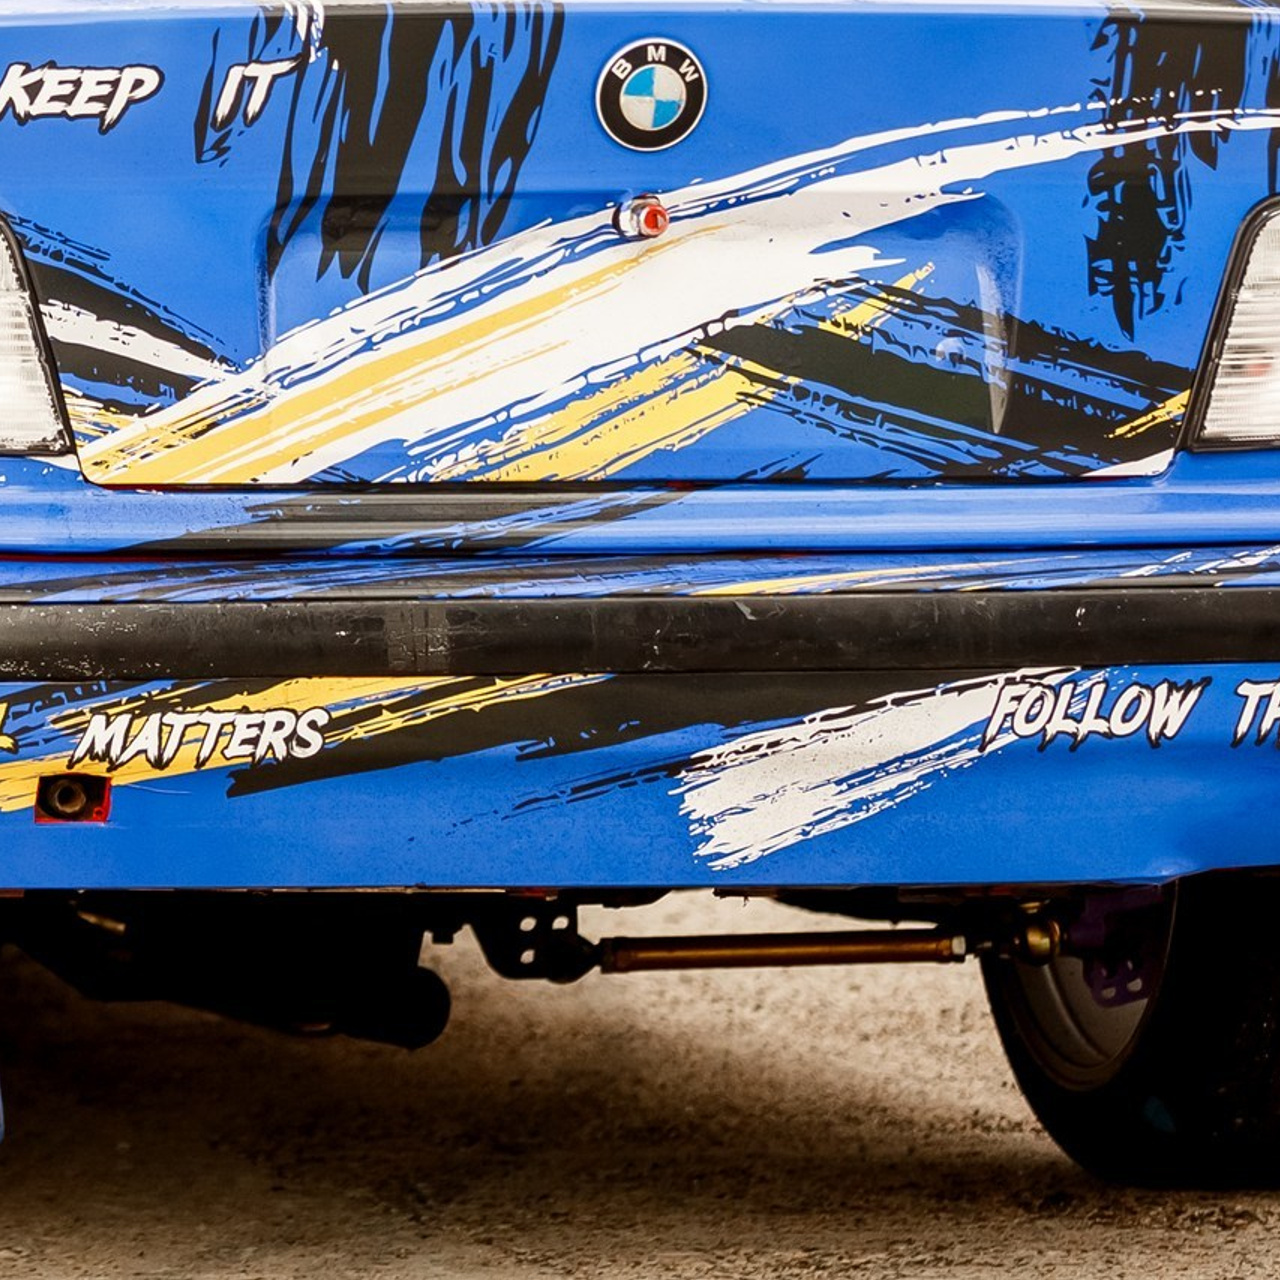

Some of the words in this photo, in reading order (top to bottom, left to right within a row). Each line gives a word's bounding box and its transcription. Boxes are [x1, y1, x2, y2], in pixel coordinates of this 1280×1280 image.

[211, 55, 308, 131] IT
[611, 44, 700, 83] BMW
[68, 706, 331, 770] MATTERS
[977, 676, 1212, 752] FOLLOW
